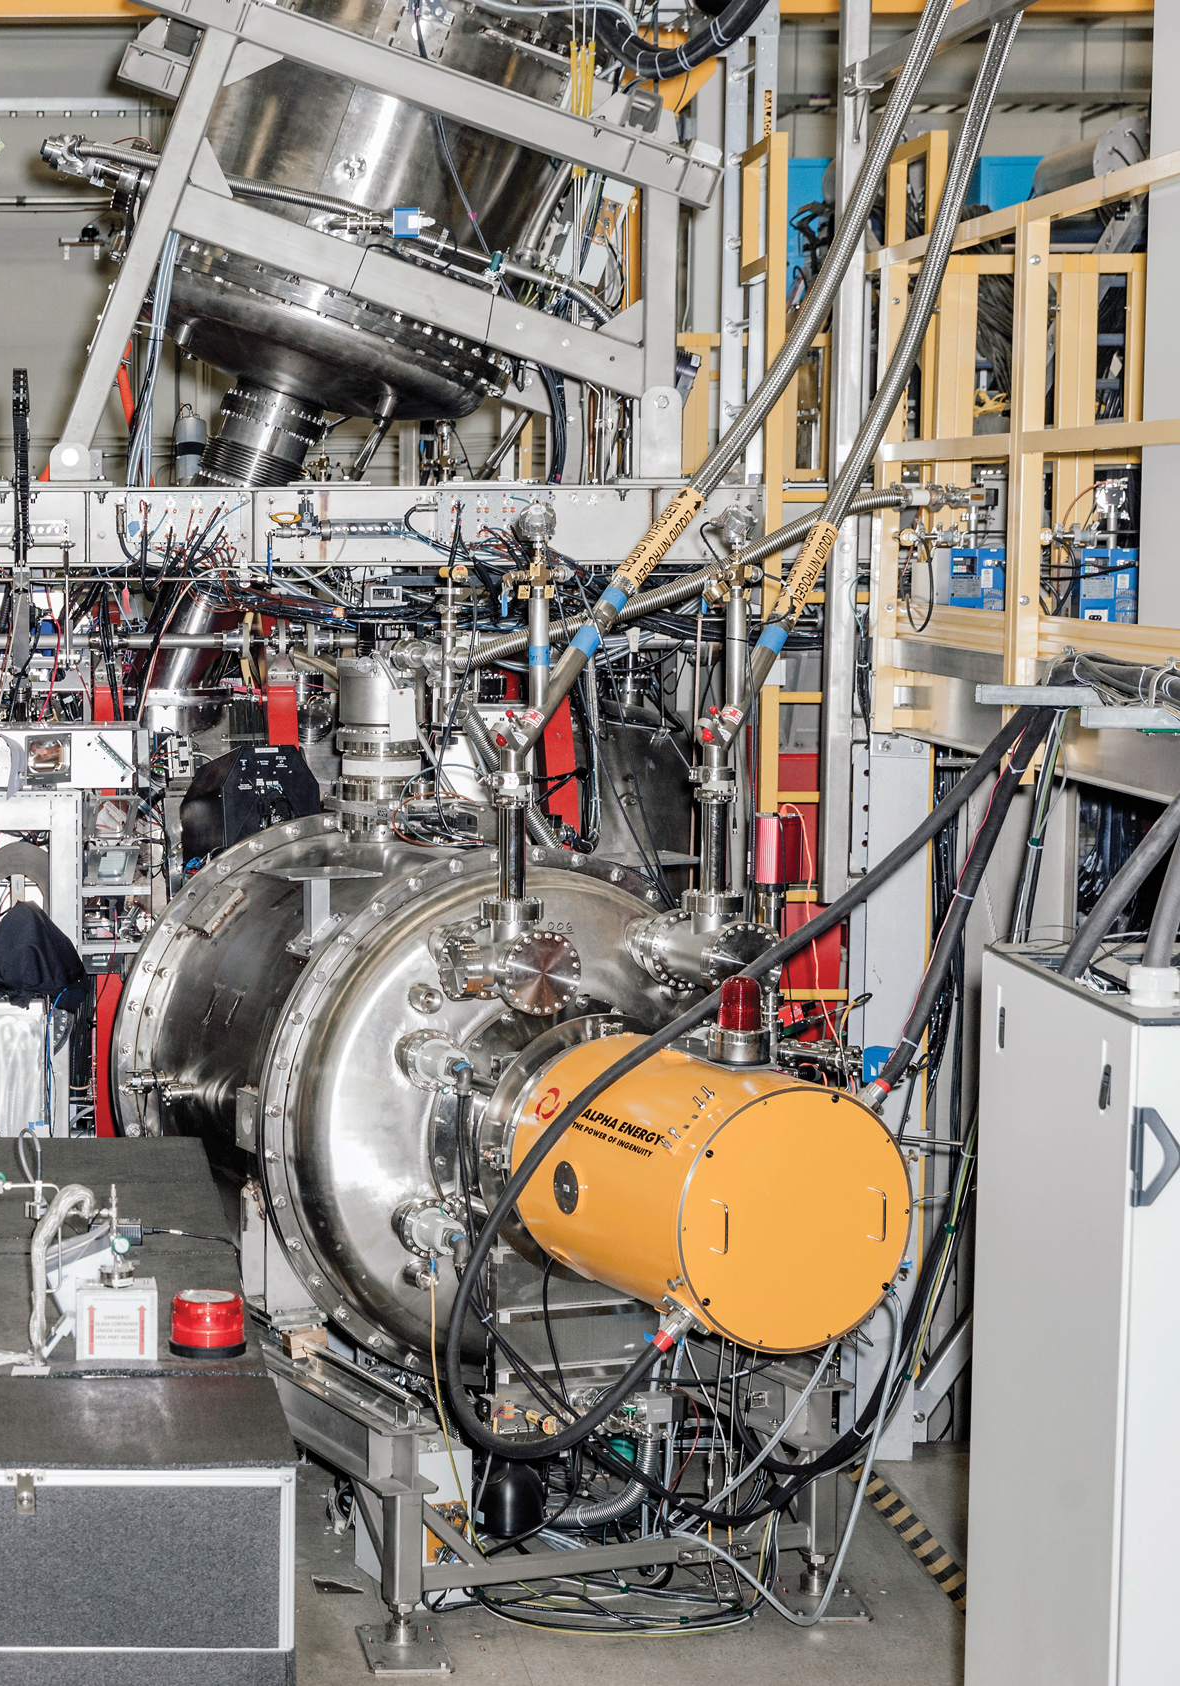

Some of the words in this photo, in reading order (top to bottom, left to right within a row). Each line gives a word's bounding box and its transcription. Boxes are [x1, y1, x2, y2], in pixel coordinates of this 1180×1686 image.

[620, 543, 647, 573] LIQUID
[641, 500, 682, 550] NITROGEN
[669, 509, 695, 542] LIQUID
[815, 527, 836, 560] LIQUID
[635, 538, 671, 585] NITROGEN
[792, 556, 822, 605] NITROGEN
[547, 921, 573, 932] 006
[571, 1121, 583, 1131] THE
[583, 1126, 608, 1141] POWER
[608, 1135, 618, 1144] OF
[617, 1139, 654, 1158] INGENUITY
[581, 1108, 619, 1130] ALPHA
[619, 1121, 664, 1146] ENERGY
